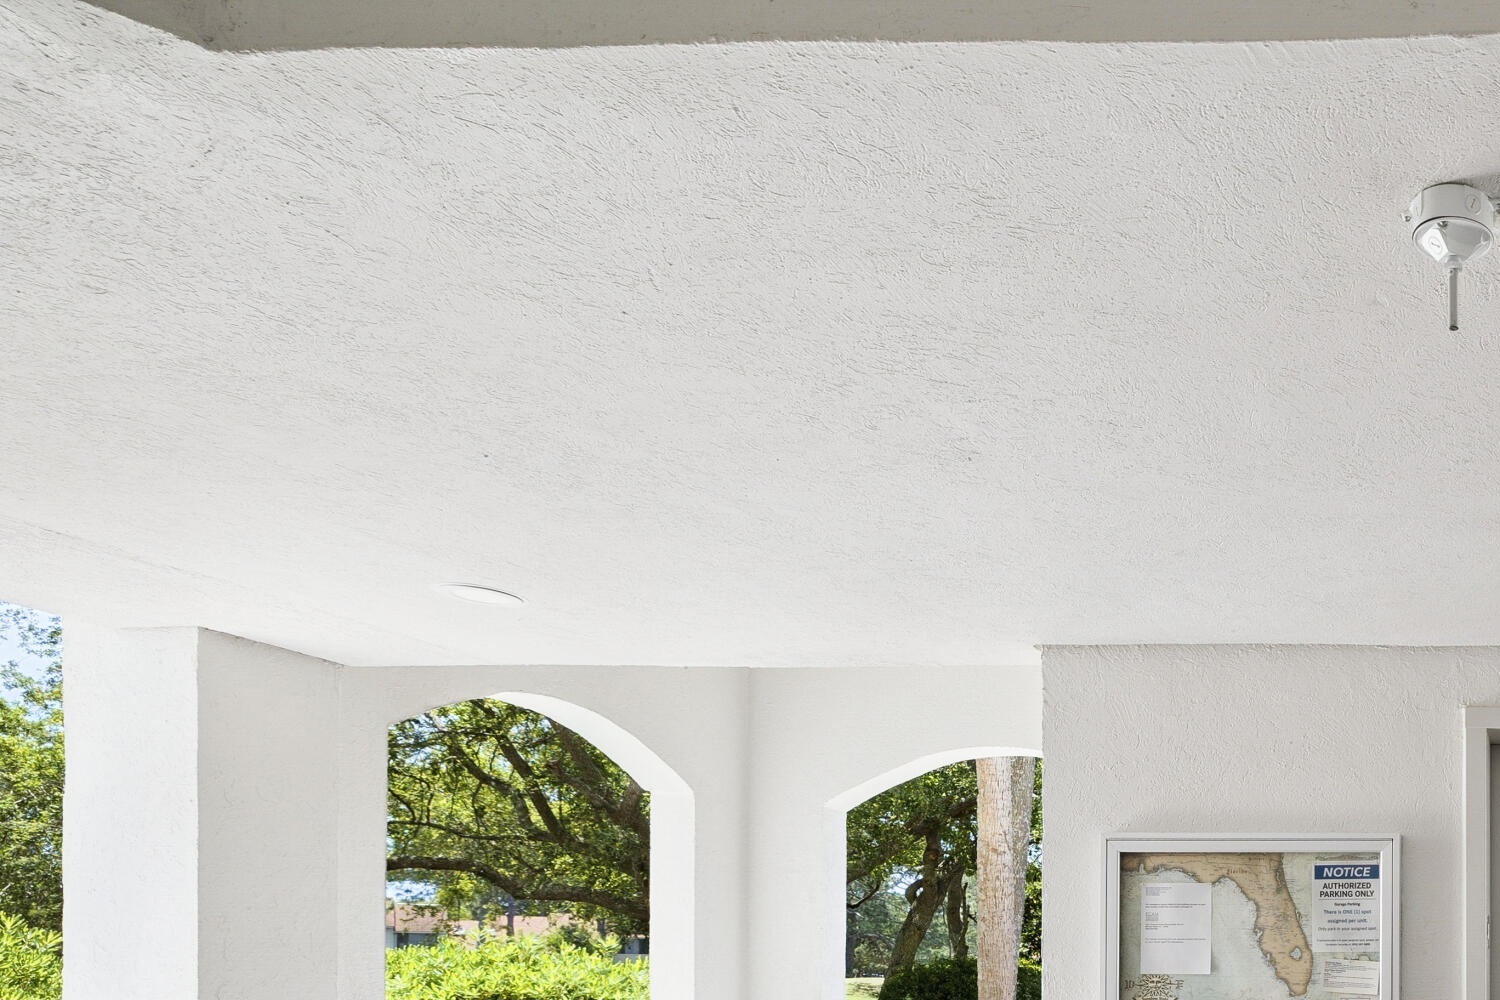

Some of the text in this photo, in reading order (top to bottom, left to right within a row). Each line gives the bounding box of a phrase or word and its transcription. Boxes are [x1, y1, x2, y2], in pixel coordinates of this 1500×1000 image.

[1323, 866, 1371, 878] NOTICE
[1322, 882, 1371, 890] AUTHORIZED
[1319, 890, 1353, 898] PARKING
